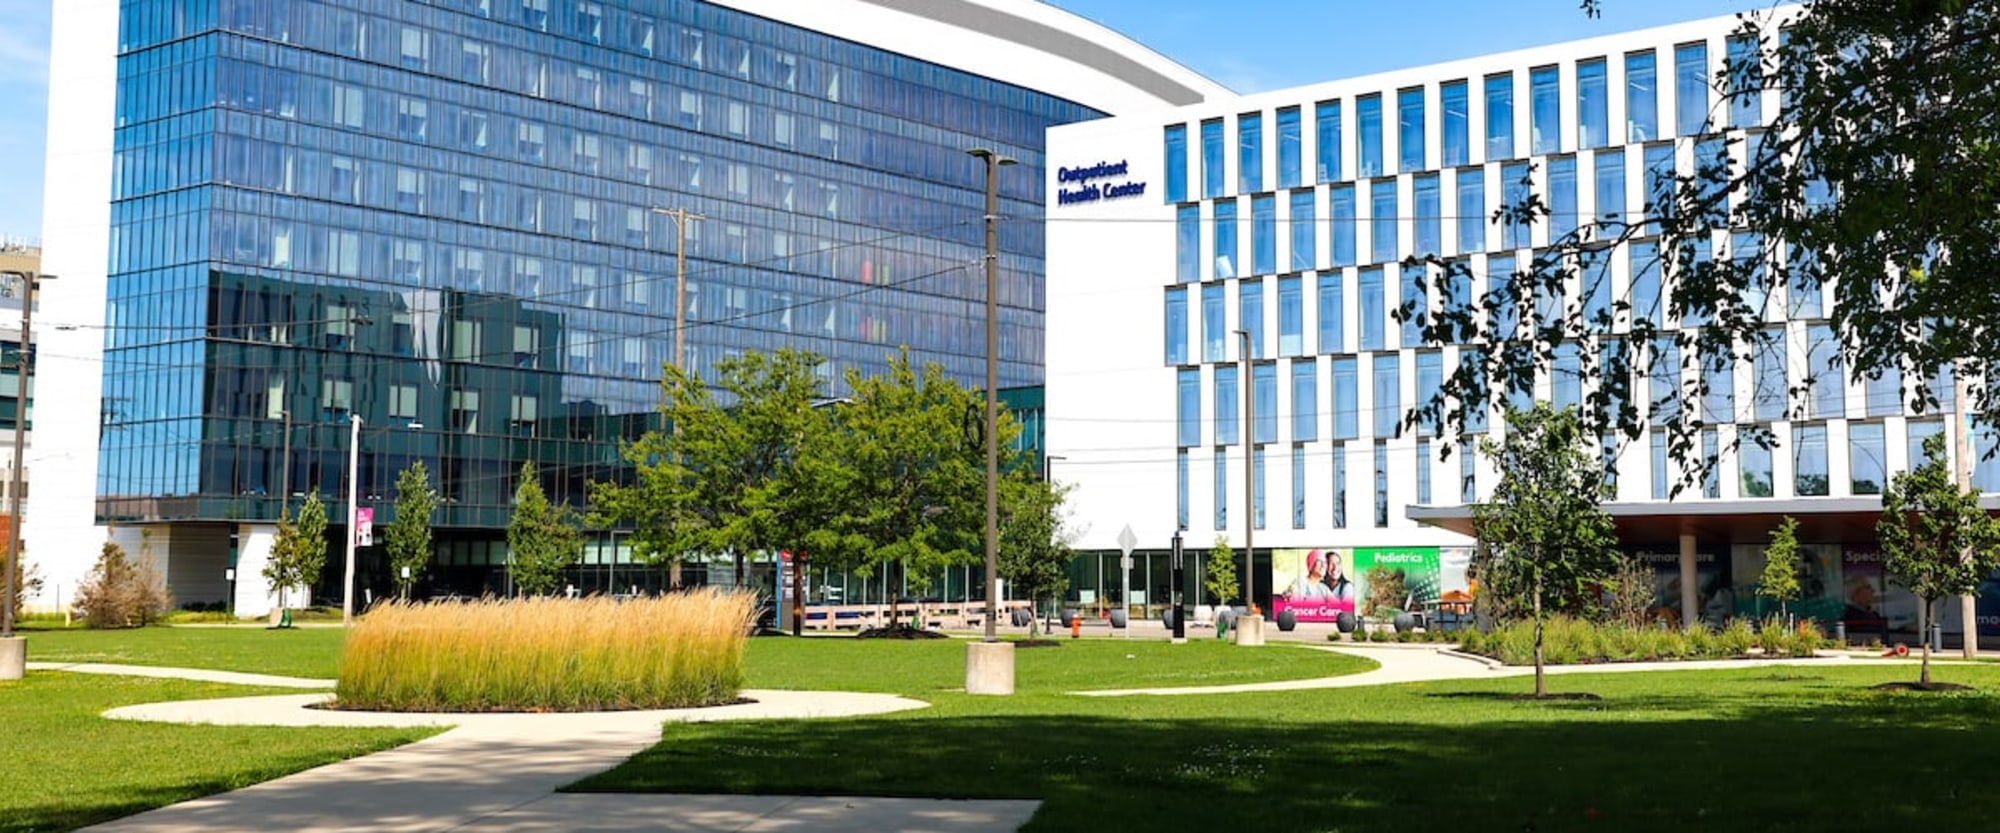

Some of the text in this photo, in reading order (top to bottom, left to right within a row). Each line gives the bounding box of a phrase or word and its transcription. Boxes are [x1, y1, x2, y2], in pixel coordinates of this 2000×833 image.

[1058, 160, 1128, 184] Outpatient
[1058, 182, 1147, 205] Health Center
[1374, 552, 1423, 563] Pediatrics
[1636, 551, 1681, 563] Primar
[1845, 550, 1889, 564] Specia
